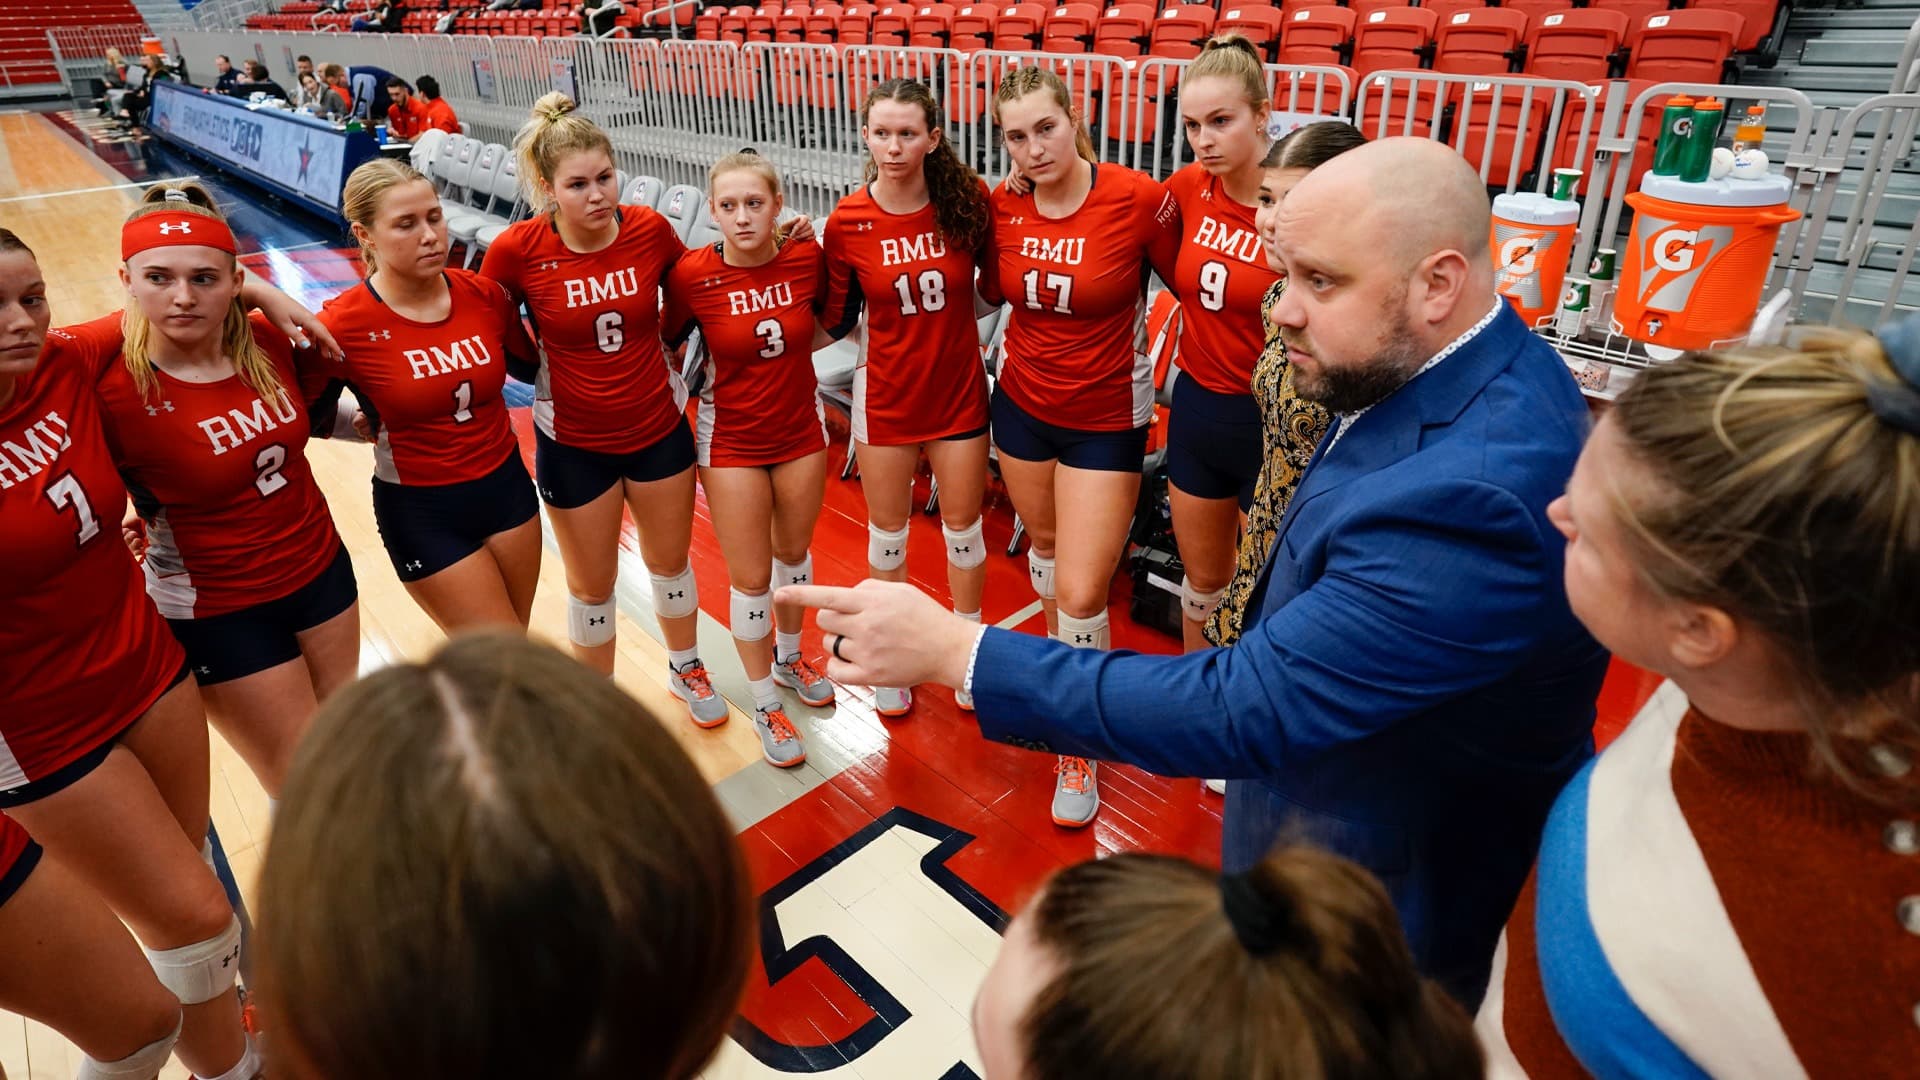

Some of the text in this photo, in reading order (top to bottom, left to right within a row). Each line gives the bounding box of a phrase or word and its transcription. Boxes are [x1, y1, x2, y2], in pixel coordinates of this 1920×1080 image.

[881, 232, 946, 266] RMU
[1020, 236, 1086, 266] RMU
[1193, 216, 1262, 263] RMU
[1500, 237, 1540, 275] G
[1653, 229, 1699, 272] G
[564, 267, 638, 308] RMU
[727, 281, 793, 315] RMU
[894, 269, 946, 316] 18
[1023, 269, 1073, 315] 17
[1199, 260, 1229, 312] 9
[594, 310, 624, 353] 6
[755, 317, 785, 359] 3
[403, 335, 491, 380] RMU
[197, 387, 297, 456] RMU
[453, 381, 474, 424] 1
[254, 443, 290, 498] 2
[44, 470, 101, 547] 7
